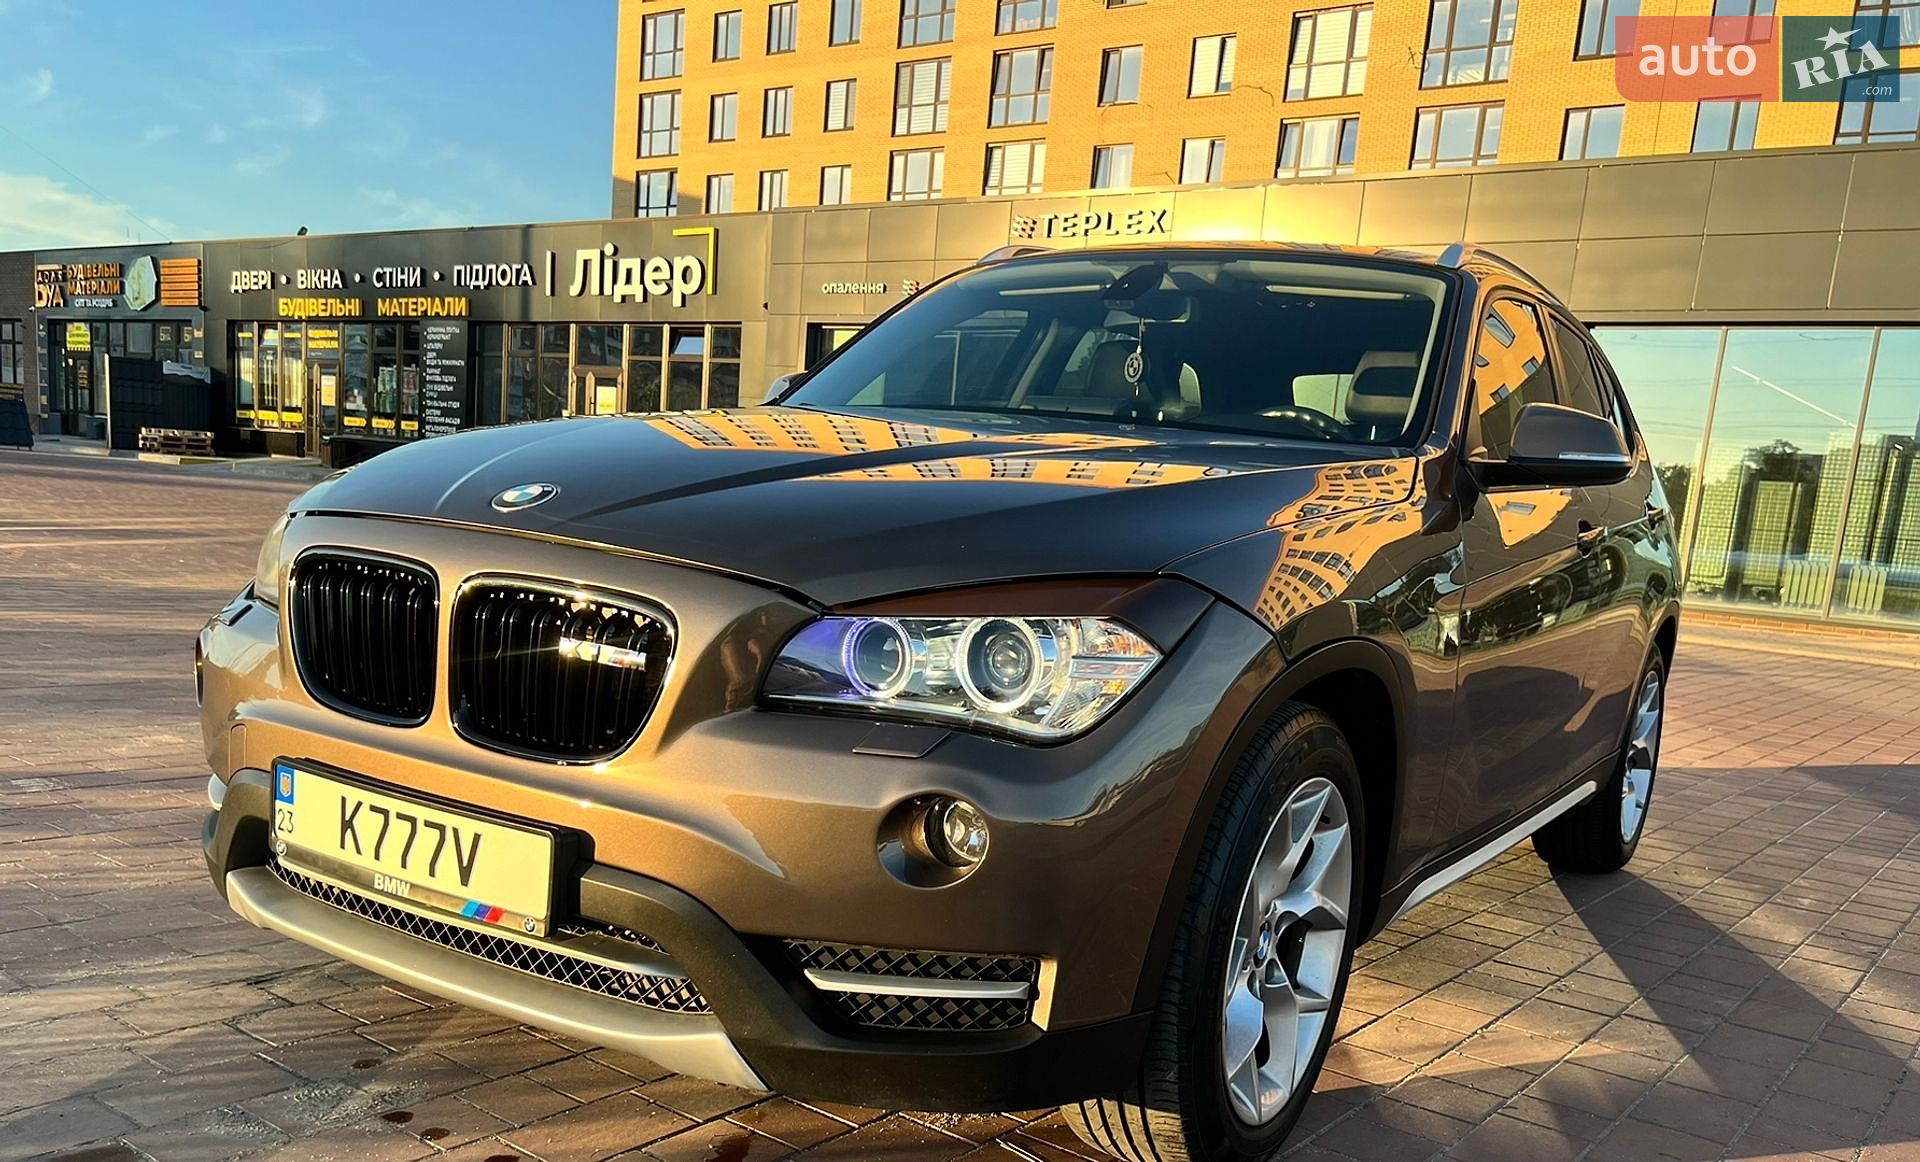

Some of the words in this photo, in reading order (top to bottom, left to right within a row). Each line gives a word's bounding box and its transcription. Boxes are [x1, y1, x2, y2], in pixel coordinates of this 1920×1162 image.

[1038, 209, 1169, 238] TEPLEX
[67, 264, 120, 280] БУДІВЕЛЬНІ
[230, 270, 272, 293] ДВЕРІ
[297, 268, 343, 290] ВІКНА
[373, 266, 421, 288] СТІНИ
[453, 263, 533, 290] ПІДЛОГА
[569, 243, 703, 307] Лідер
[68, 280, 121, 296] МАТЕРІАЛИ
[821, 281, 885, 294] опалення
[278, 298, 361, 319] БУДІВЕЛЬНІ
[377, 297, 467, 317] МАТЕРІАЛИ
[278, 808, 294, 833] 23
[340, 795, 482, 887] K777V
[374, 873, 411, 898] BMW
